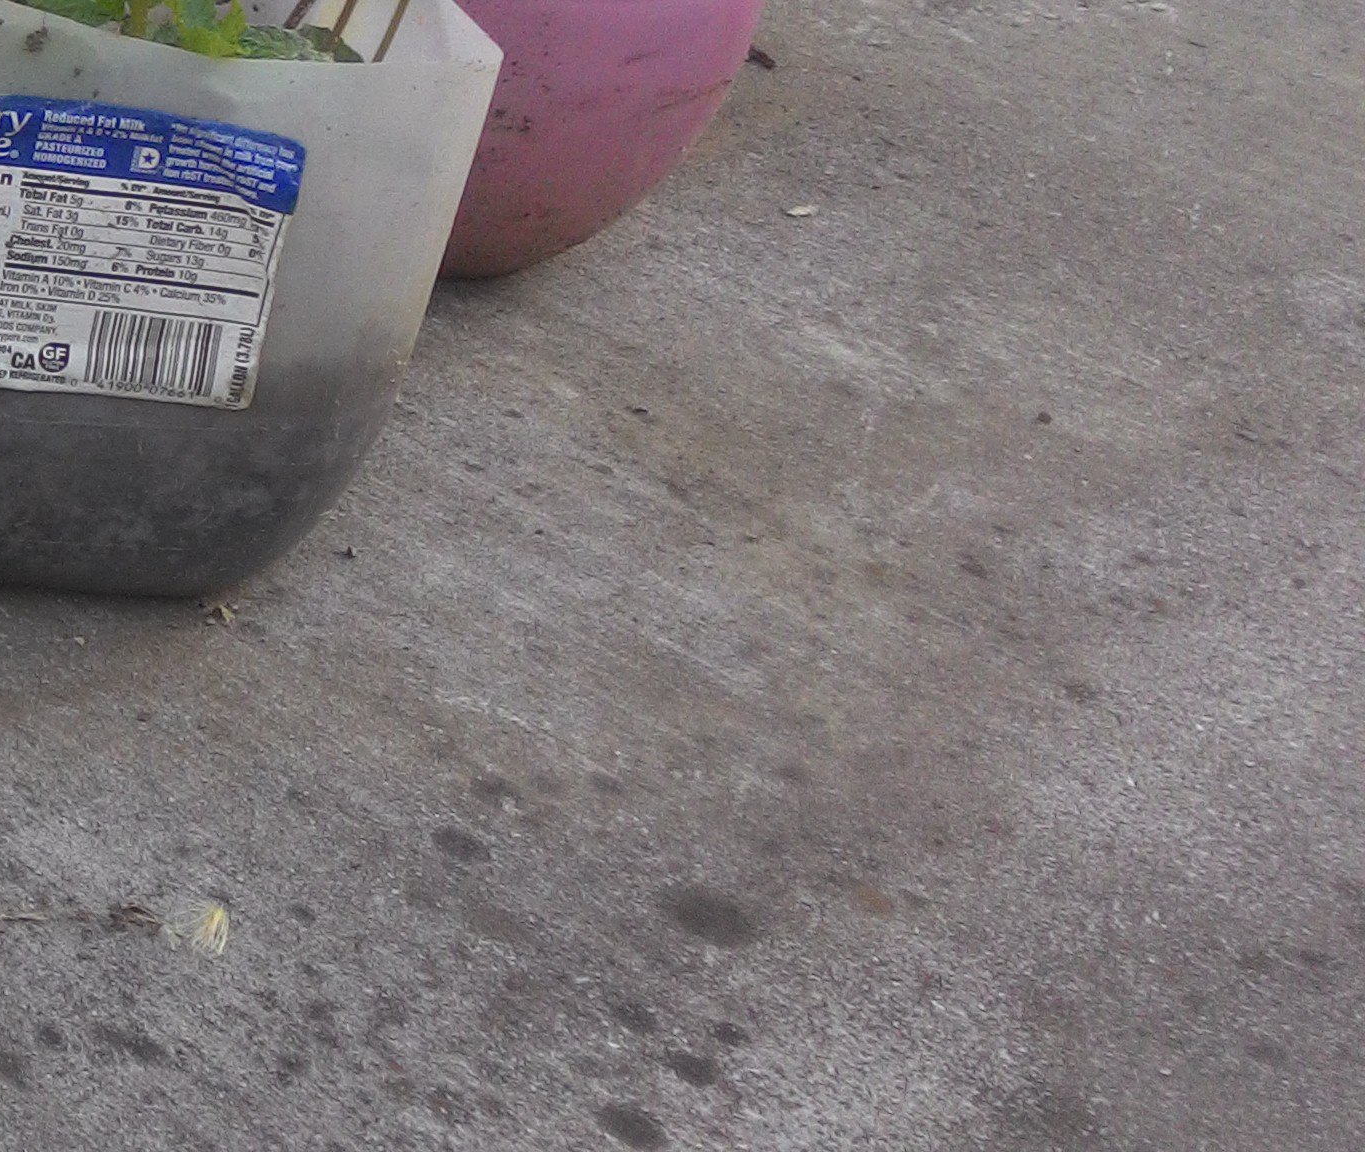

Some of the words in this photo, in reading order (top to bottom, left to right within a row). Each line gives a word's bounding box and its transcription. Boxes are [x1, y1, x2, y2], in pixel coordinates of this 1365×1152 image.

[44, 109, 95, 125] Reduced
[96, 115, 117, 128] Fat
[119, 117, 144, 130] Milk
[37, 131, 72, 142] GRADE
[73, 134, 82, 144] A
[35, 140, 104, 157] PASTEURIZED
[32, 151, 106, 168] HOMOGENIZED
[19, 187, 47, 200] Total
[49, 191, 68, 203] Fat
[69, 194, 84, 208] 5g
[124, 200, 142, 211] 8%
[22, 203, 43, 217] Sat.
[45, 207, 63, 219] Fat
[64, 209, 79, 224] 3g
[115, 214, 139, 226] 15%
[148, 202, 207, 219] Potassium
[208, 211, 247, 229] 460mg
[20, 219, 49, 233] Trans
[51, 223, 68, 235] Fat
[69, 226, 84, 240] 0g
[146, 218, 173, 231] Total
[175, 222, 204, 235] Carb.
[207, 226, 229, 241] 14g
[8, 234, 53, 249] Cholest.
[55, 240, 86, 255] 20mg
[149, 235, 186, 250] Dietary
[188, 240, 215, 251] Fiber
[216, 243, 232, 257] 0g
[6, 249, 48, 263] Sodium
[51, 255, 88, 270] 150mg
[110, 261, 128, 272] 6%
[145, 249, 182, 265] Sugars
[183, 254, 205, 269] 13g
[135, 264, 175, 278] Protein
[177, 269, 198, 284] 10g
[0, 281, 19, 292] Iron
[20, 283, 38, 294] 0%
[47, 286, 85, 299] Vitamin
[86, 290, 96, 301] D
[96, 291, 120, 303] 25%
[1, 269, 40, 282] Vitamin
[41, 273, 49, 284] A
[52, 275, 74, 287] 10%
[83, 278, 121, 291] Vitamin
[122, 283, 131, 293] C
[132, 284, 150, 295] 4%
[159, 287, 200, 301] Calcium
[202, 292, 226, 304] 35%
[6, 309, 41, 320] VITAMIN
[36, 302, 57, 312] SKIM
[15, 322, 58, 334] COMPANY,
[41, 345, 66, 360] GF
[235, 327, 255, 364] (3.78L)
[10, 351, 35, 370] CA
[228, 365, 248, 403] GALLON
